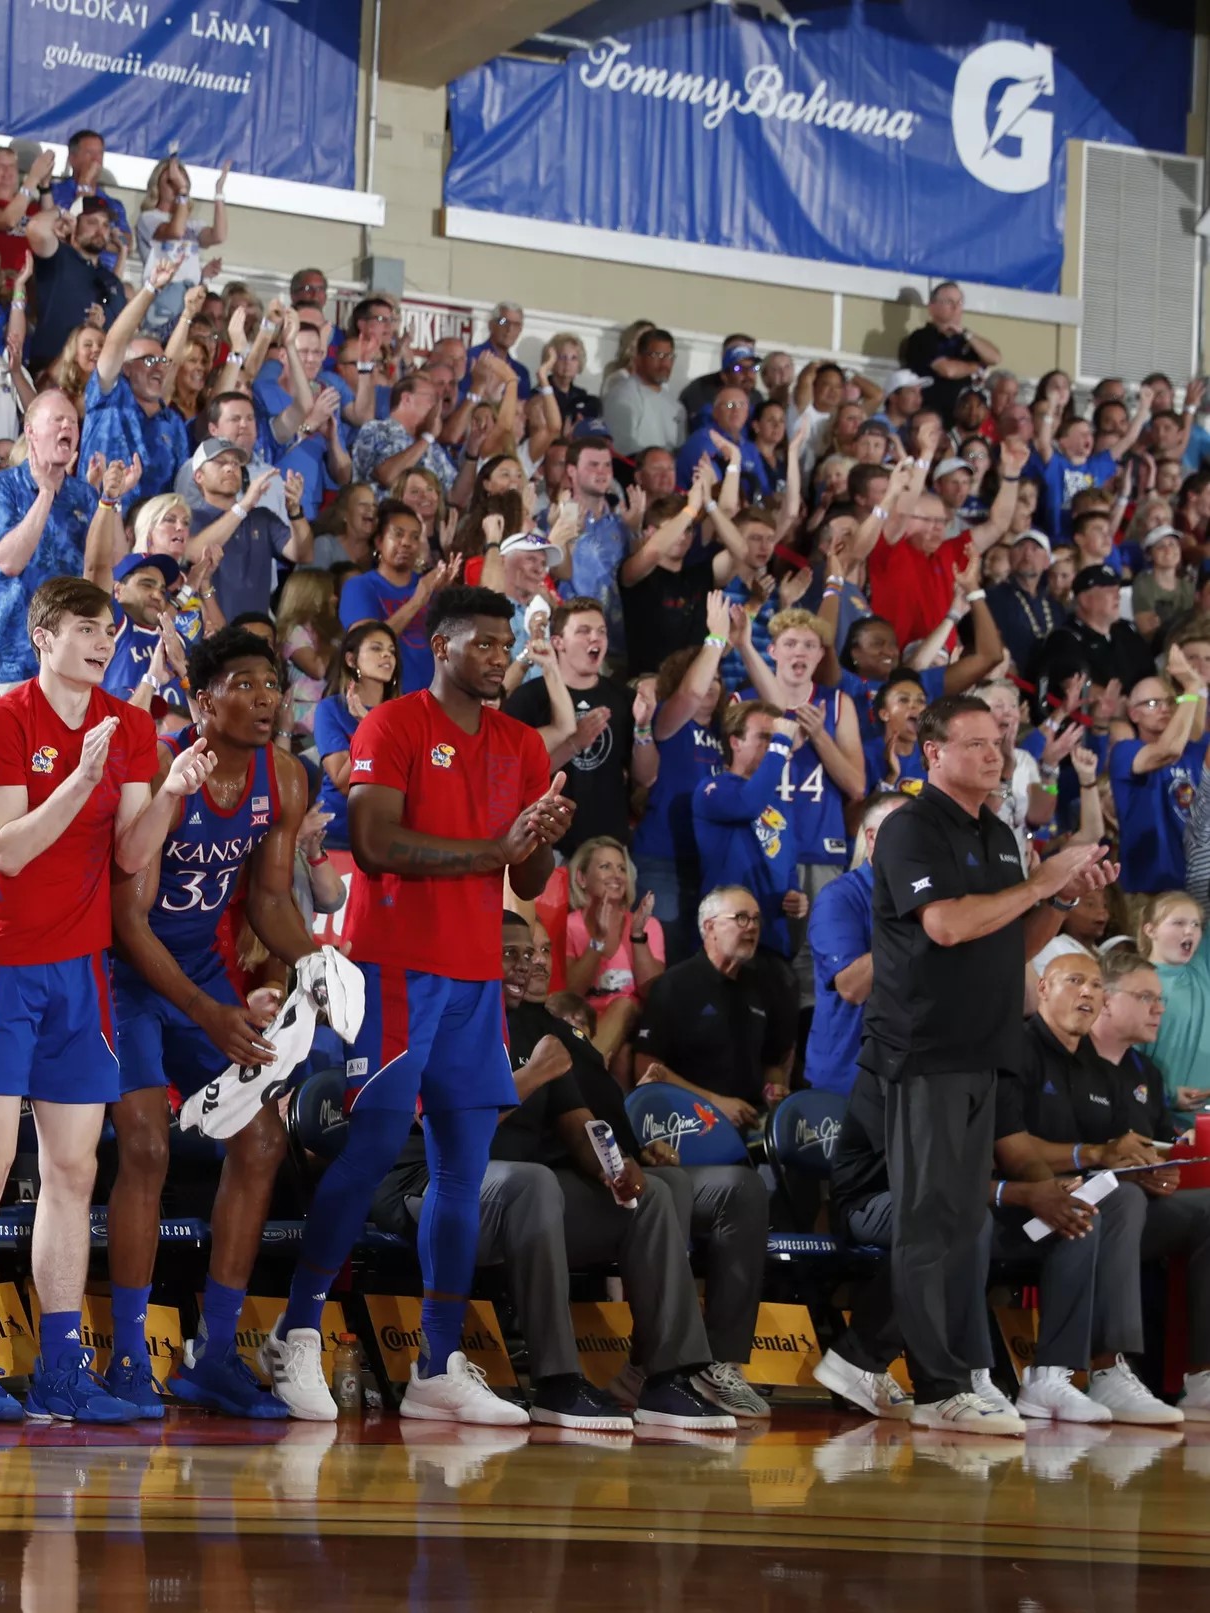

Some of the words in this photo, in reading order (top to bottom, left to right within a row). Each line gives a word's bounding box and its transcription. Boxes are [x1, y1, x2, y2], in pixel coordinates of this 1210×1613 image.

[42, 42, 252, 96] gohawaii.com/maui
[579, 36, 739, 129] Tommy
[735, 64, 916, 140] Bahama
